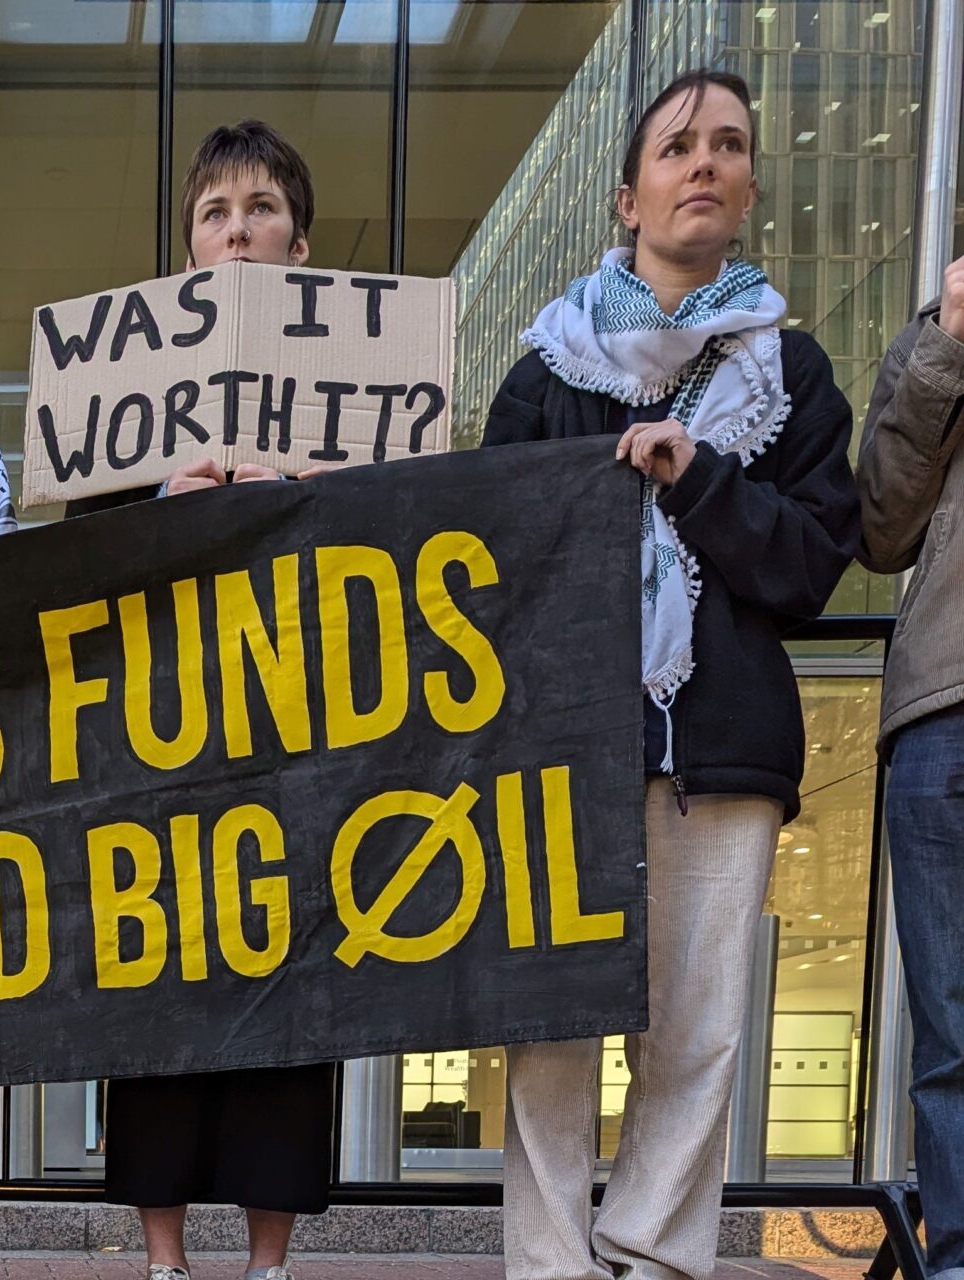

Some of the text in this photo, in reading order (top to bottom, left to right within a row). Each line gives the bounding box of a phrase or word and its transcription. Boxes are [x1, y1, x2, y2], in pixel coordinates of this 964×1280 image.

[38, 270, 400, 372] WAS IT
[37, 530, 506, 783] FUNDS
[86, 803, 292, 989] BIG
